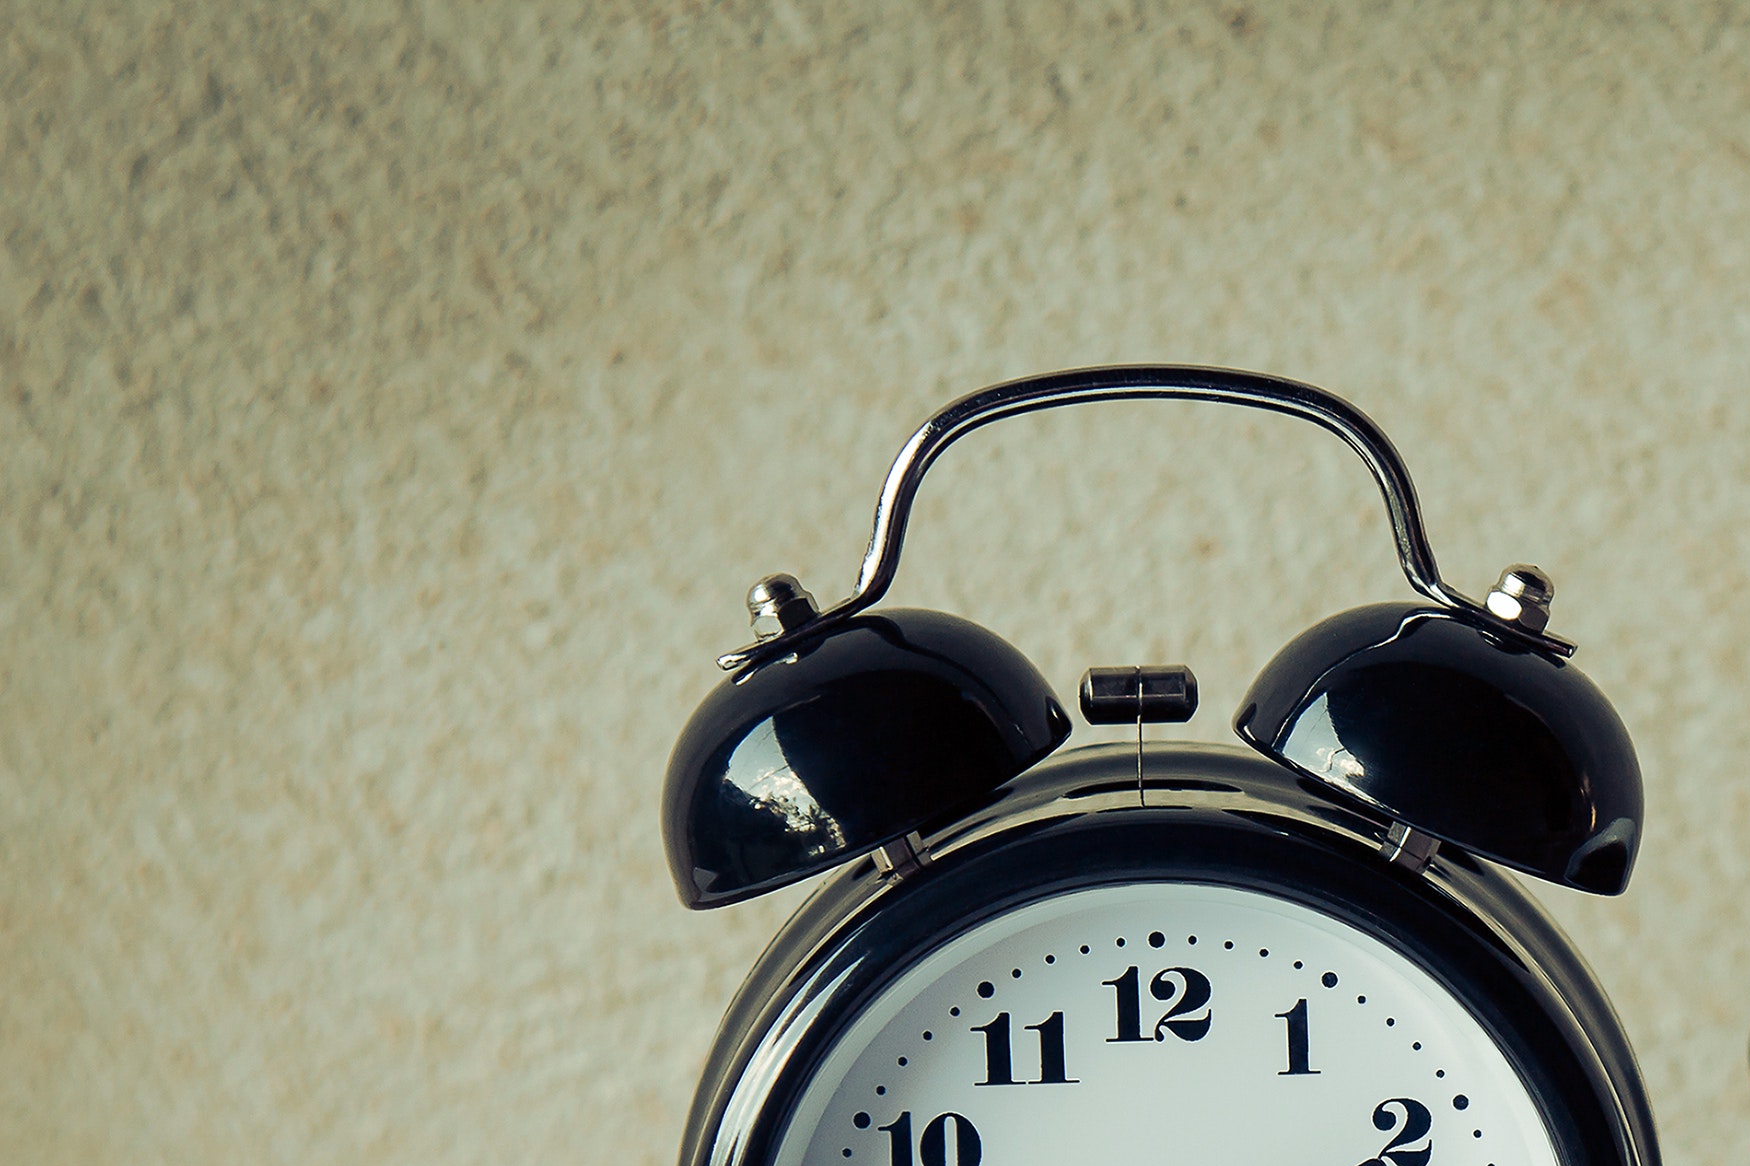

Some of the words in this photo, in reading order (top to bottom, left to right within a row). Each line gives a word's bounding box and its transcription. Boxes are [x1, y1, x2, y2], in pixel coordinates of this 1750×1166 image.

[1102, 966, 1212, 1043] 12
[1275, 998, 1322, 1076] 1
[970, 1011, 1081, 1087] 11
